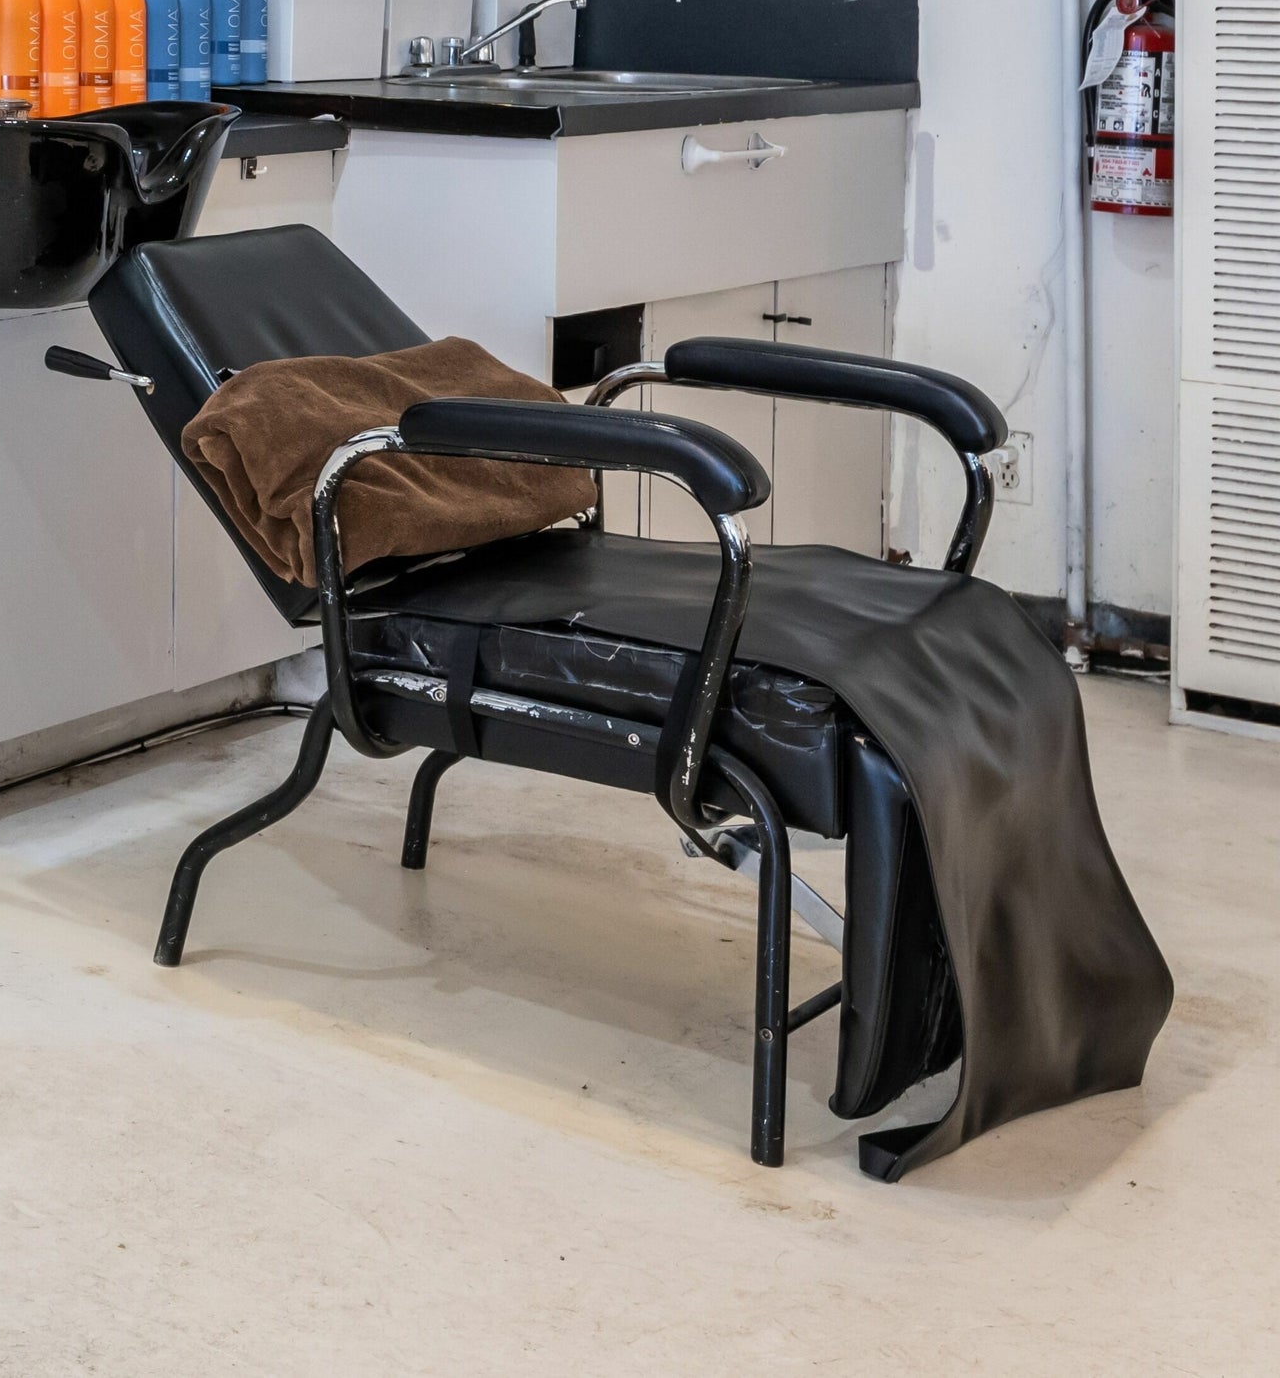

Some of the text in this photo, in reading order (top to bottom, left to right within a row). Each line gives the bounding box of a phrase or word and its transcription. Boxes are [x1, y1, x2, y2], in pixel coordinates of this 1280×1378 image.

[62, 10, 78, 71] LOMA
[93, 10, 109, 70] LOMA
[129, 9, 145, 69] LOMA
